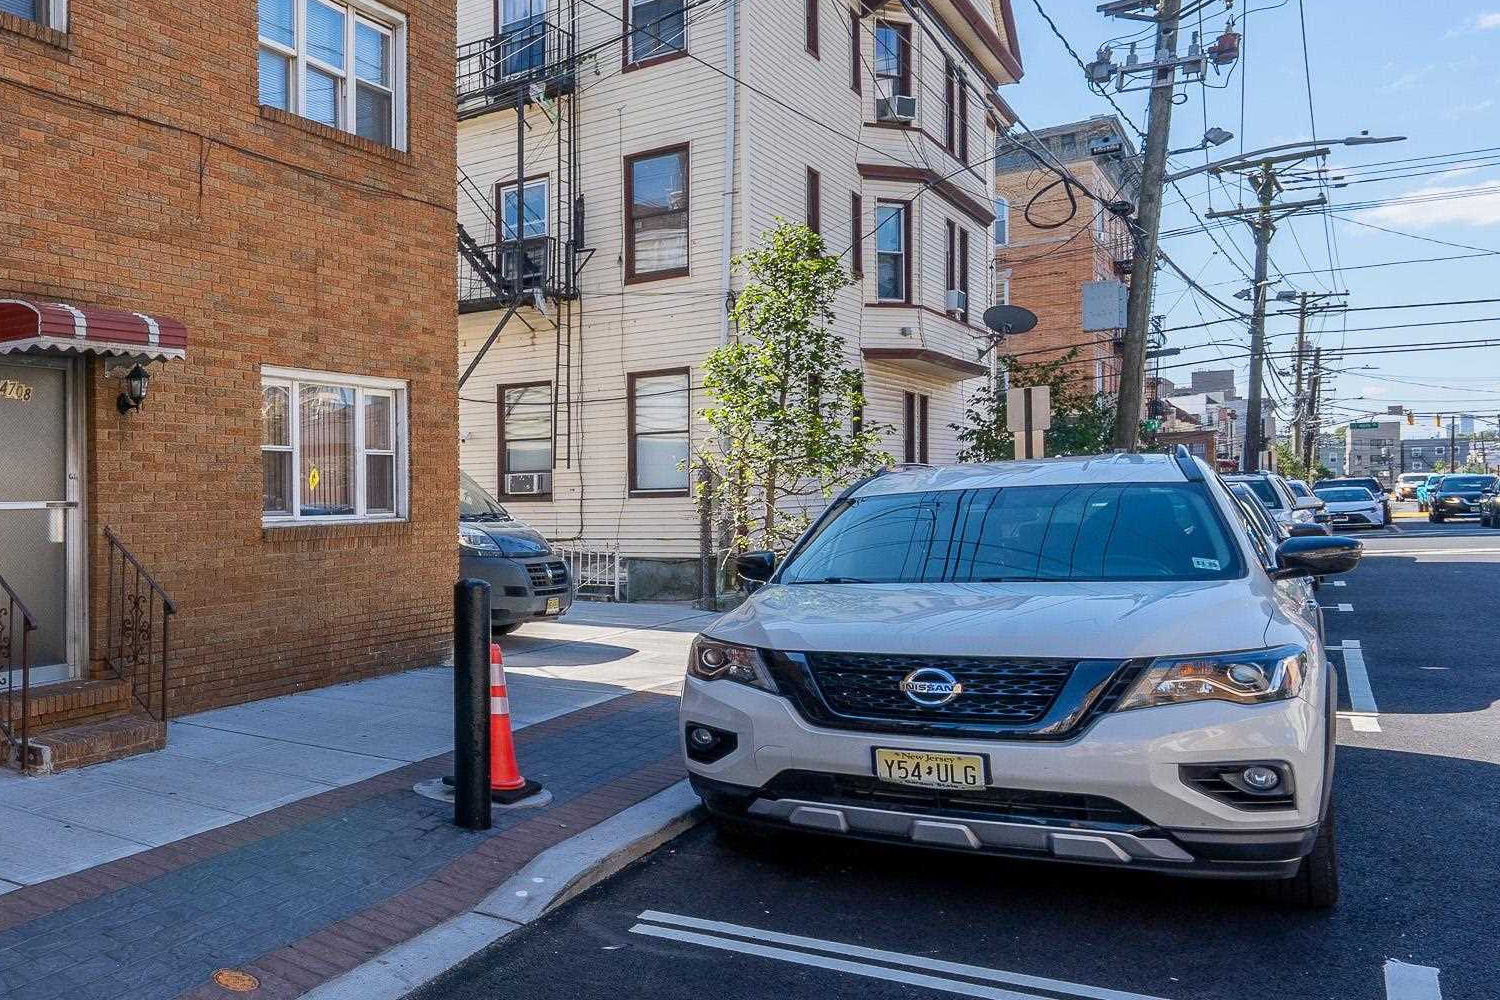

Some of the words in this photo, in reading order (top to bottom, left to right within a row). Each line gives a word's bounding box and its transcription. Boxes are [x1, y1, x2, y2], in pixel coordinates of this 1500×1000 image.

[0, 380, 31, 401] 4708
[905, 682, 954, 693] NISSAN
[901, 752, 924, 760] New
[884, 759, 922, 781] Y54
[936, 763, 977, 785] ULG
